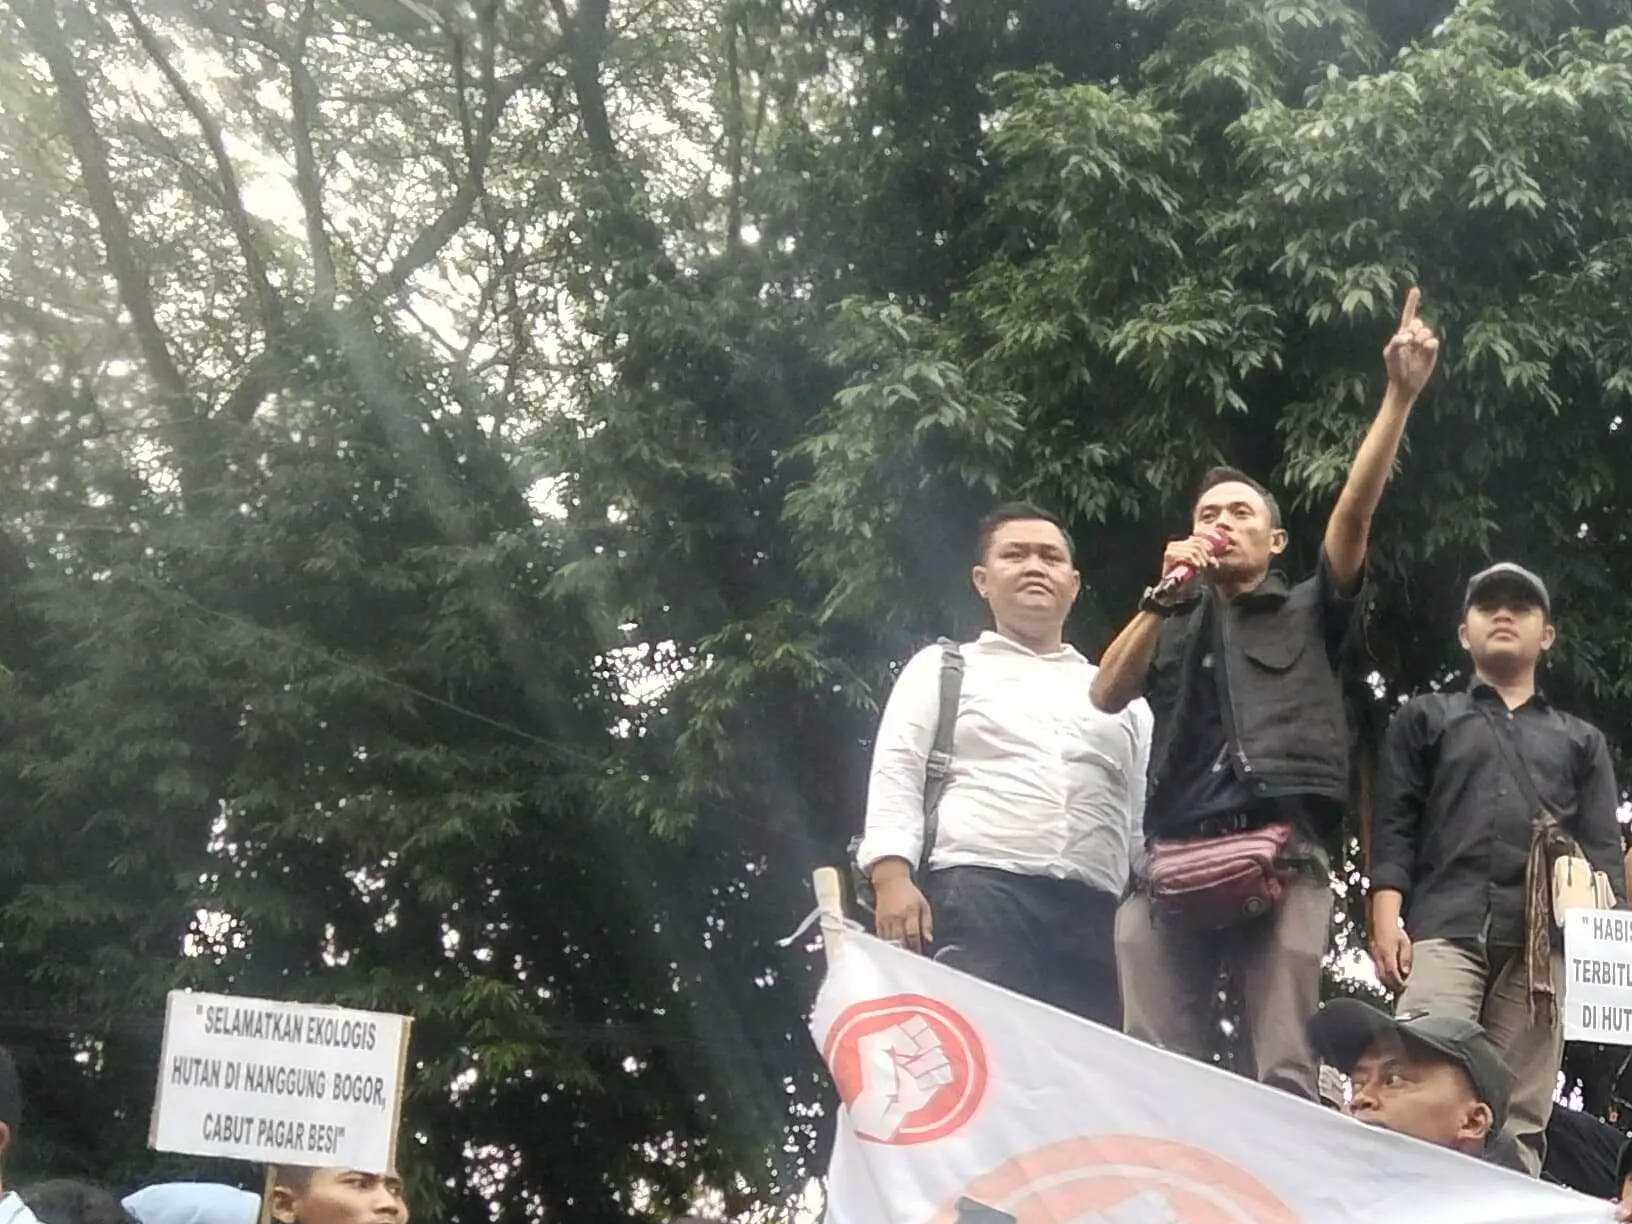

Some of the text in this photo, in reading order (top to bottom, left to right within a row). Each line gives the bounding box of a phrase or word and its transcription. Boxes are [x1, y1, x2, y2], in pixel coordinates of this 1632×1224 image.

[204, 1006, 303, 1042] SELAMATKAN
[306, 1016, 376, 1051] EKOLOGIS
[1582, 1004, 1597, 1029] DI
[171, 1055, 387, 1111] HUTAN DI NANGGUNG BOGOR,
[203, 1113, 254, 1143] CABUT
[256, 1118, 305, 1149] PAGAR
